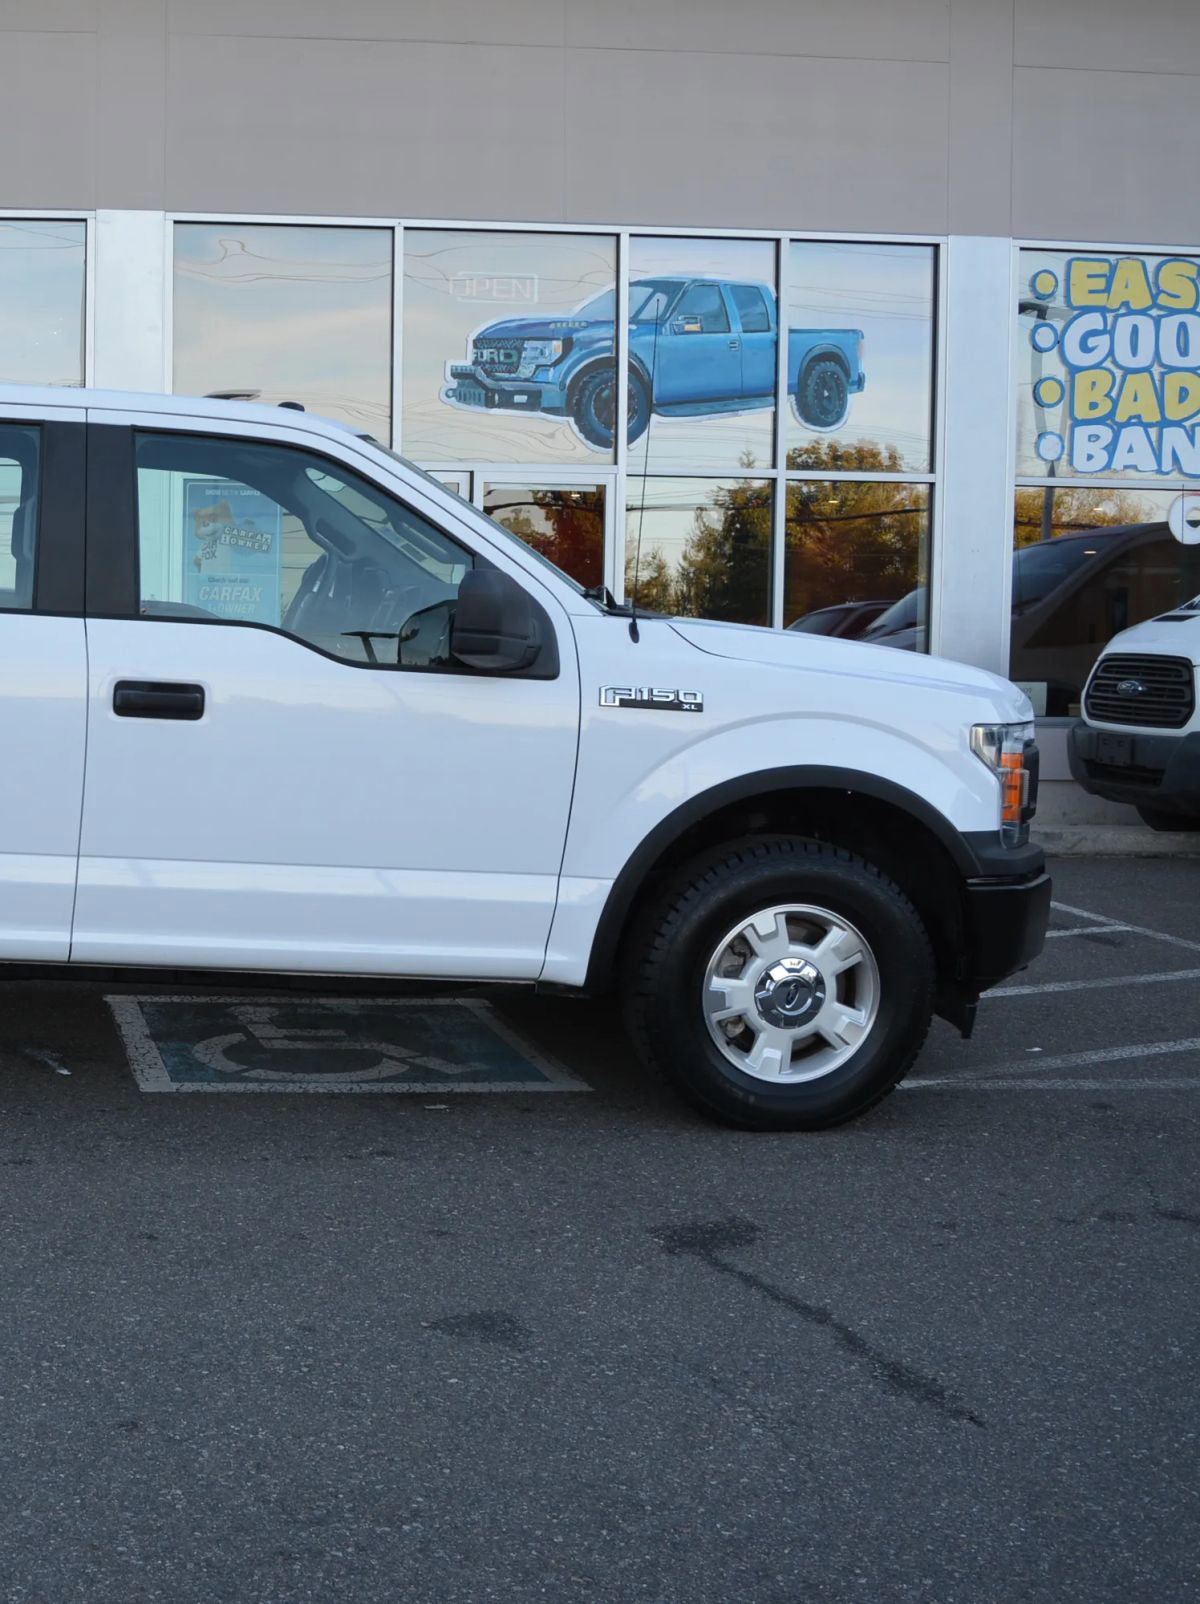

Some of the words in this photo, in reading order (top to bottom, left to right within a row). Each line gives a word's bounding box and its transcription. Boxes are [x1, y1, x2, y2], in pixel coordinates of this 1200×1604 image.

[449, 277, 531, 298] OPEN
[199, 586, 263, 600] CARFAX
[682, 703, 698, 711] XL
